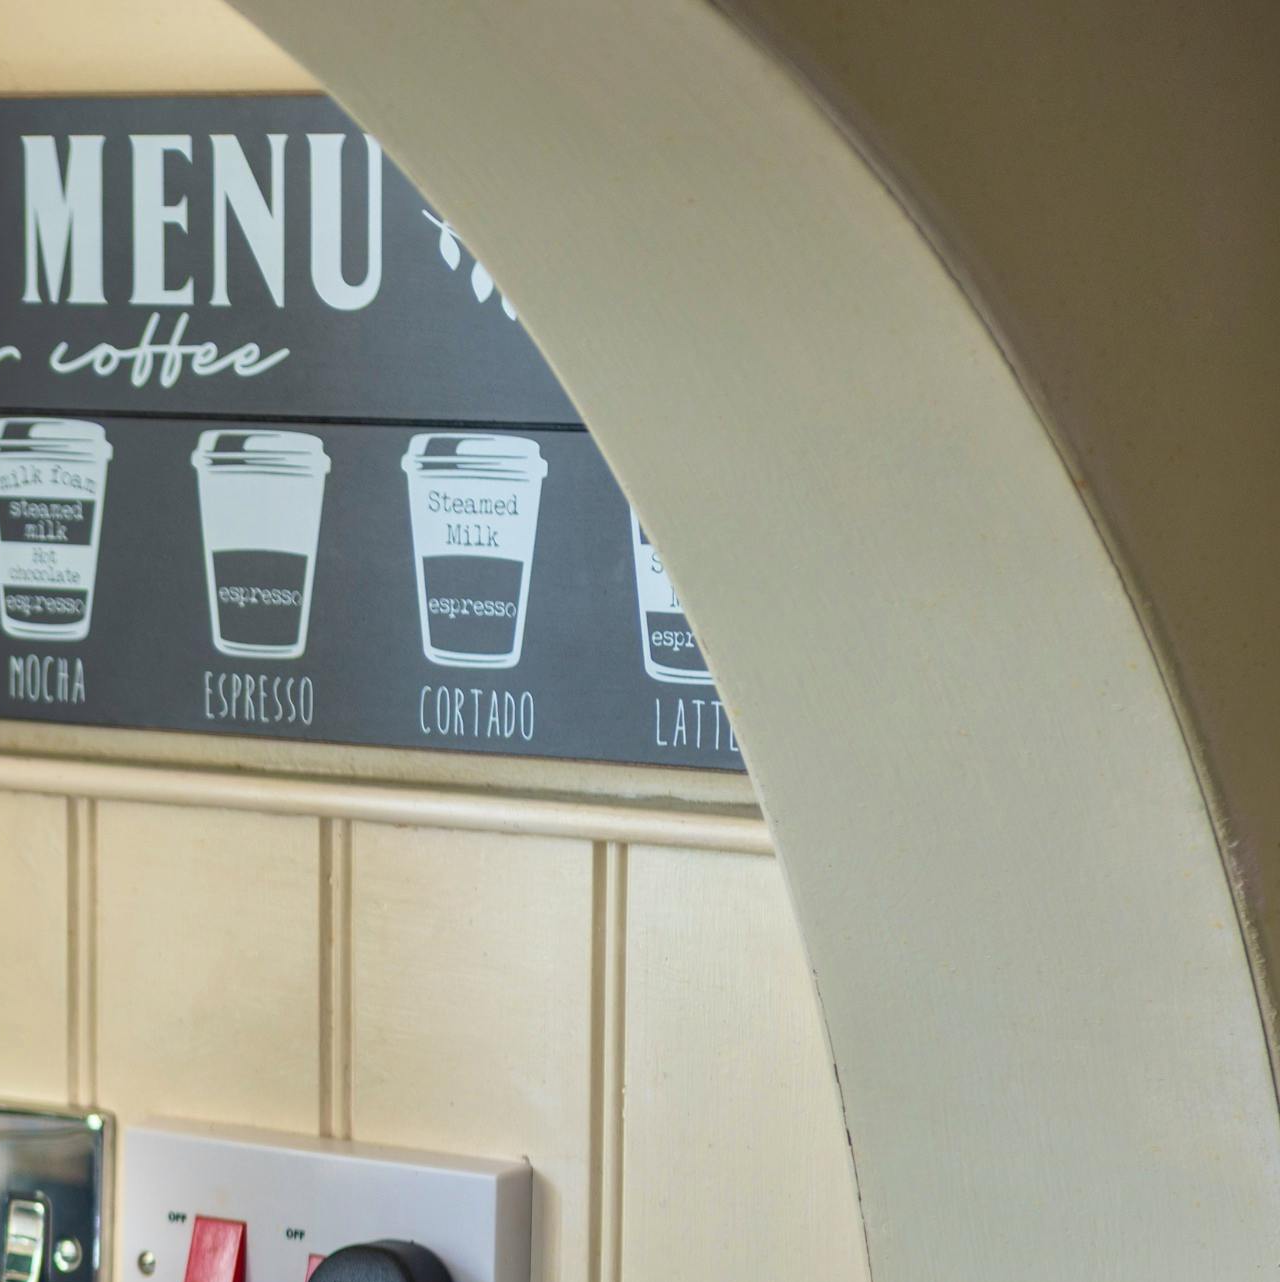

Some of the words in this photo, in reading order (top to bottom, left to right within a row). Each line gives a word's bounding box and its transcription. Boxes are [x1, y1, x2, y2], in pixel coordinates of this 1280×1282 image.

[21, 133, 383, 311] MENU
[49, 311, 290, 389] coffee
[9, 500, 84, 521] steamed
[427, 490, 520, 516] Steamed
[24, 520, 69, 541] milk
[446, 523, 500, 548] Milk
[218, 585, 304, 607] espresso
[428, 596, 518, 620] espresso
[651, 629, 695, 651] espr
[8, 654, 86, 705] MOCHA
[203, 671, 314, 726] ESPRESSO
[420, 685, 535, 741] CORTADO
[167, 1212, 187, 1224] OFF
[286, 1228, 306, 1240] OFF
